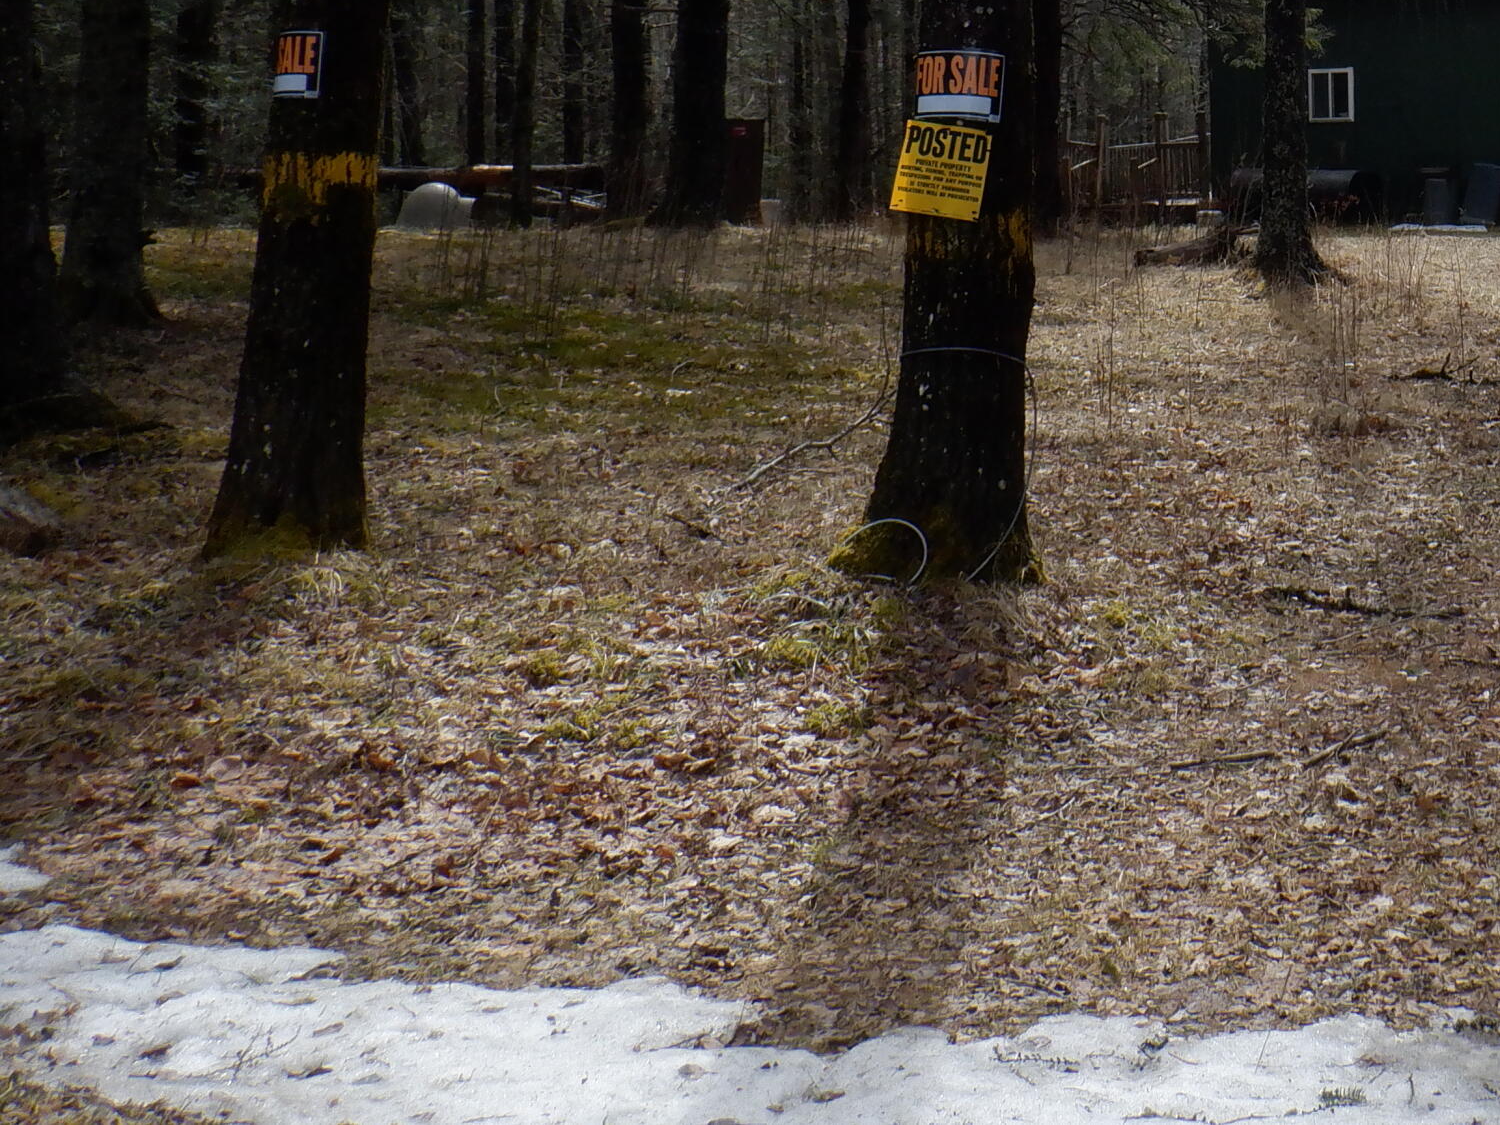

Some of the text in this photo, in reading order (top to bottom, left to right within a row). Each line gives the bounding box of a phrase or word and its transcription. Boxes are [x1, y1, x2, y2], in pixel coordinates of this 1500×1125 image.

[916, 54, 1001, 98] FOR SALE
[905, 125, 988, 164] POSTED
